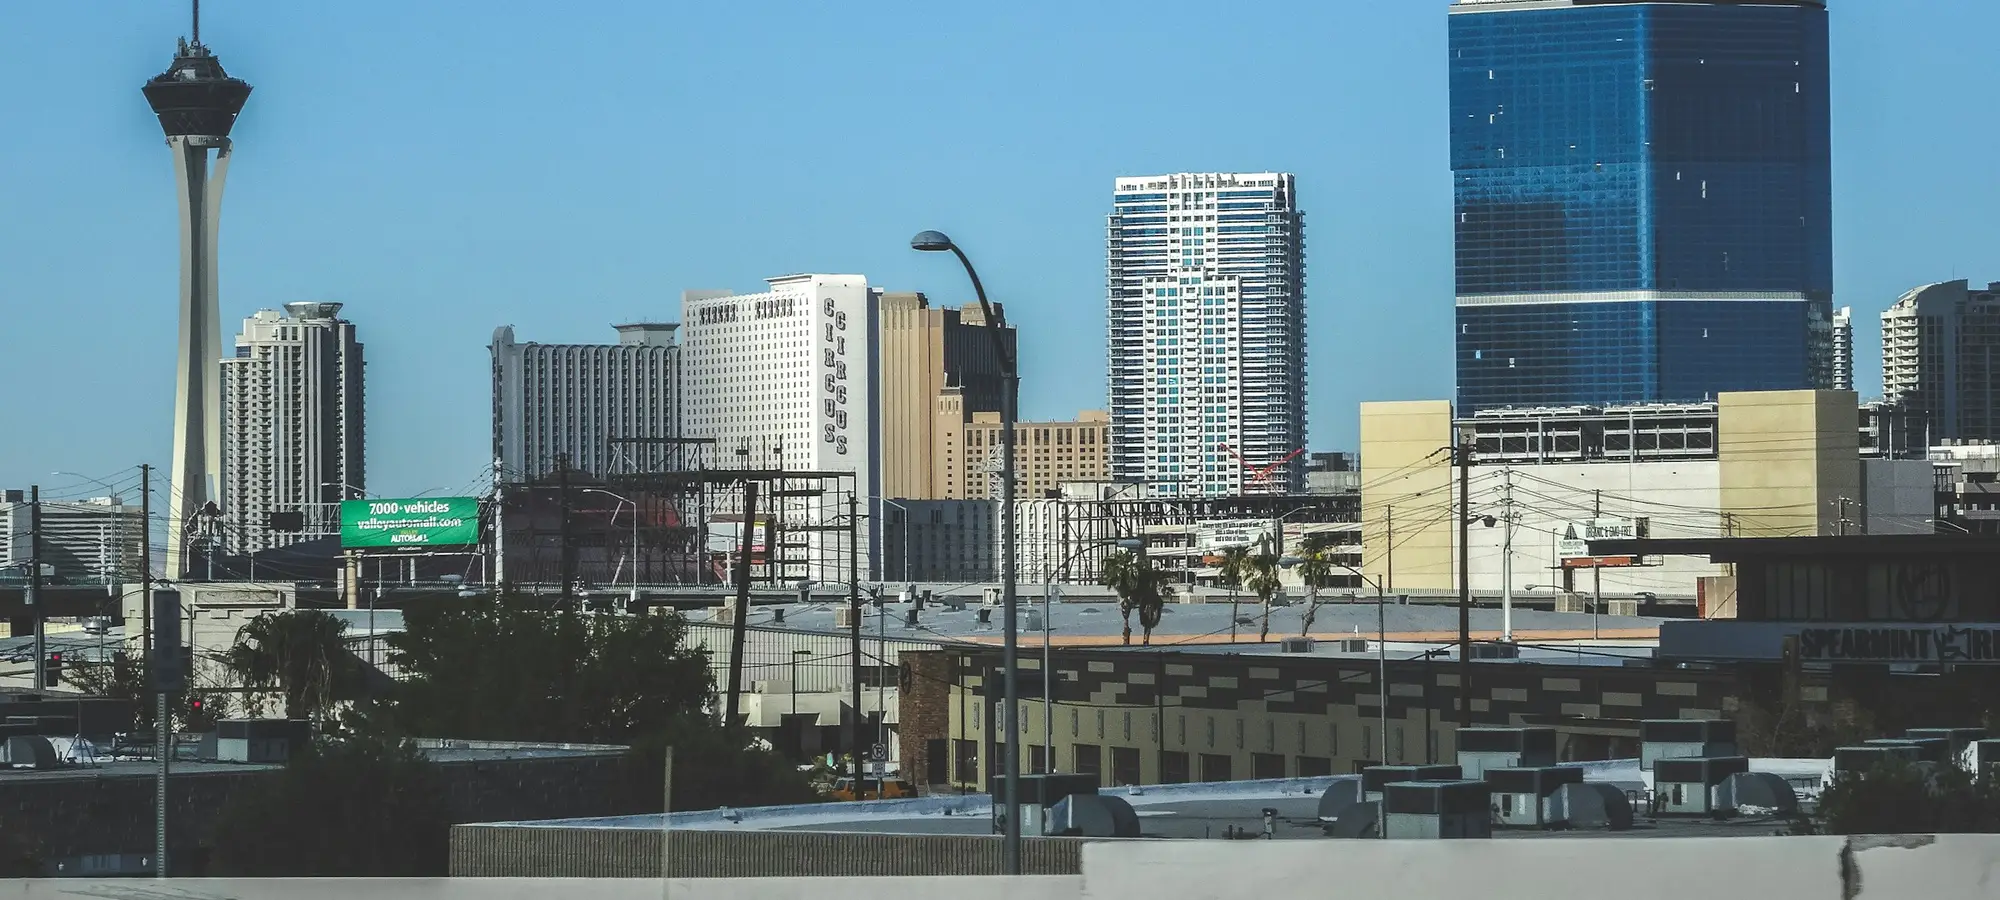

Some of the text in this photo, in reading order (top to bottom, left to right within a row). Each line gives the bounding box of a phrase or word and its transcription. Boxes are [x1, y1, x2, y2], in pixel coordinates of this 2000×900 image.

[824, 298, 835, 443] CIRCUS
[835, 311, 847, 455] CIRCUS
[404, 502, 449, 513] vehicles
[1801, 628, 1932, 659] SPEARMINT
